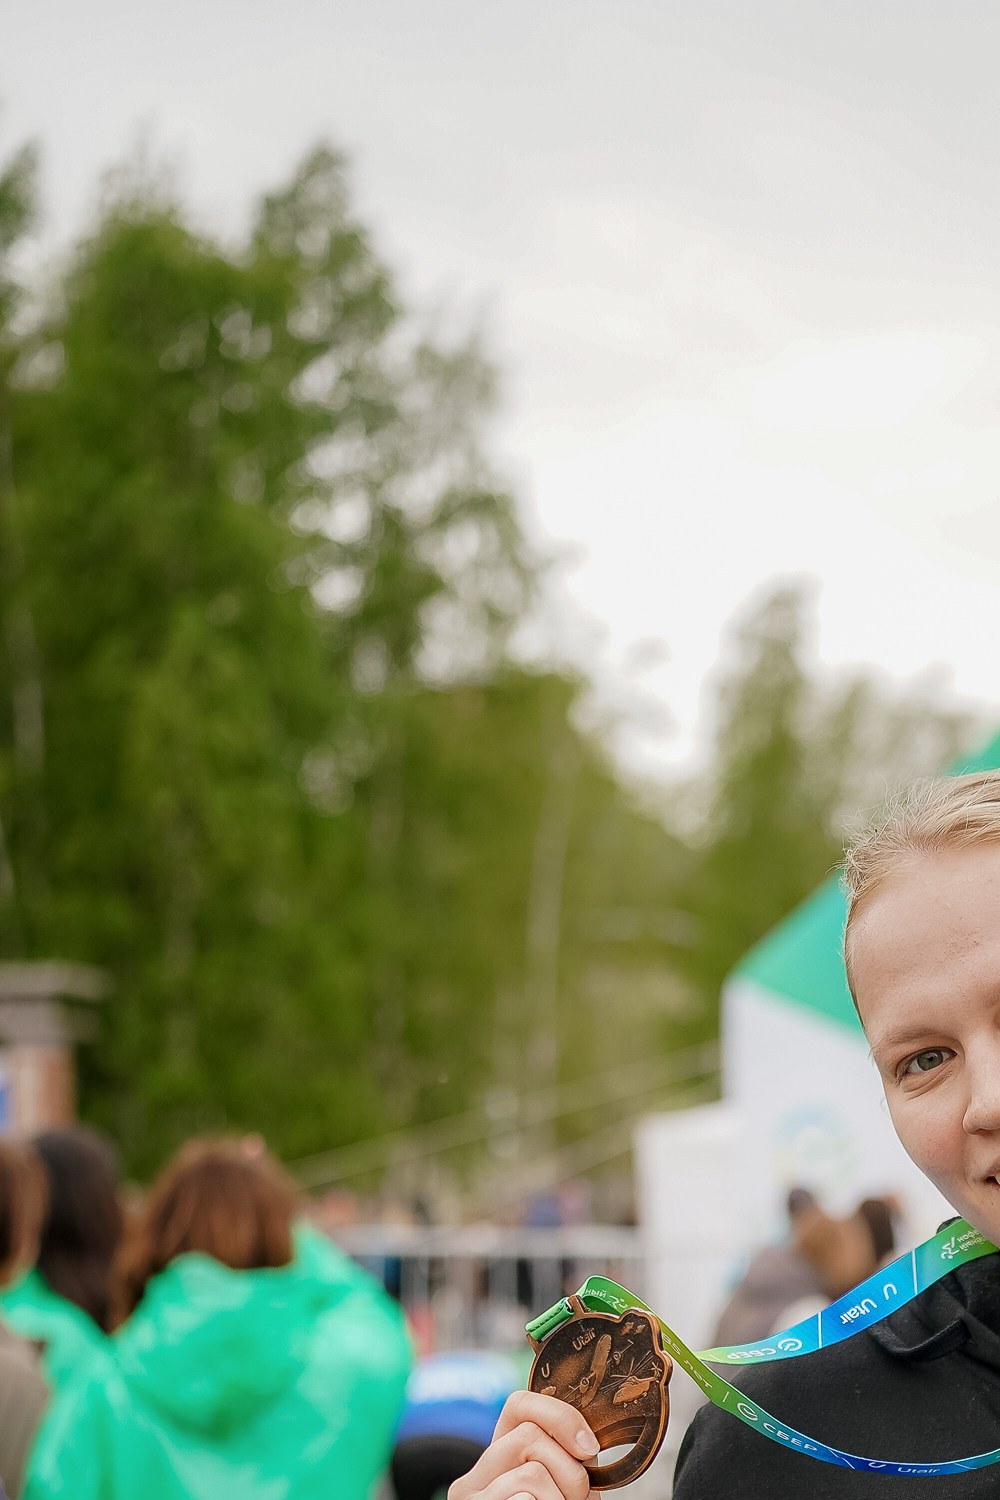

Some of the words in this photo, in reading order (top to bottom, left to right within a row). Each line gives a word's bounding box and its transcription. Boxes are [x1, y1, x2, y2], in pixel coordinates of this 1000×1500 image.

[839, 1298, 877, 1325] Utair
[572, 1327, 597, 1351] Utair
[726, 1347, 777, 1359] СБЕР
[763, 1422, 818, 1451] СБЕР
[897, 1466, 941, 1474] Utair
